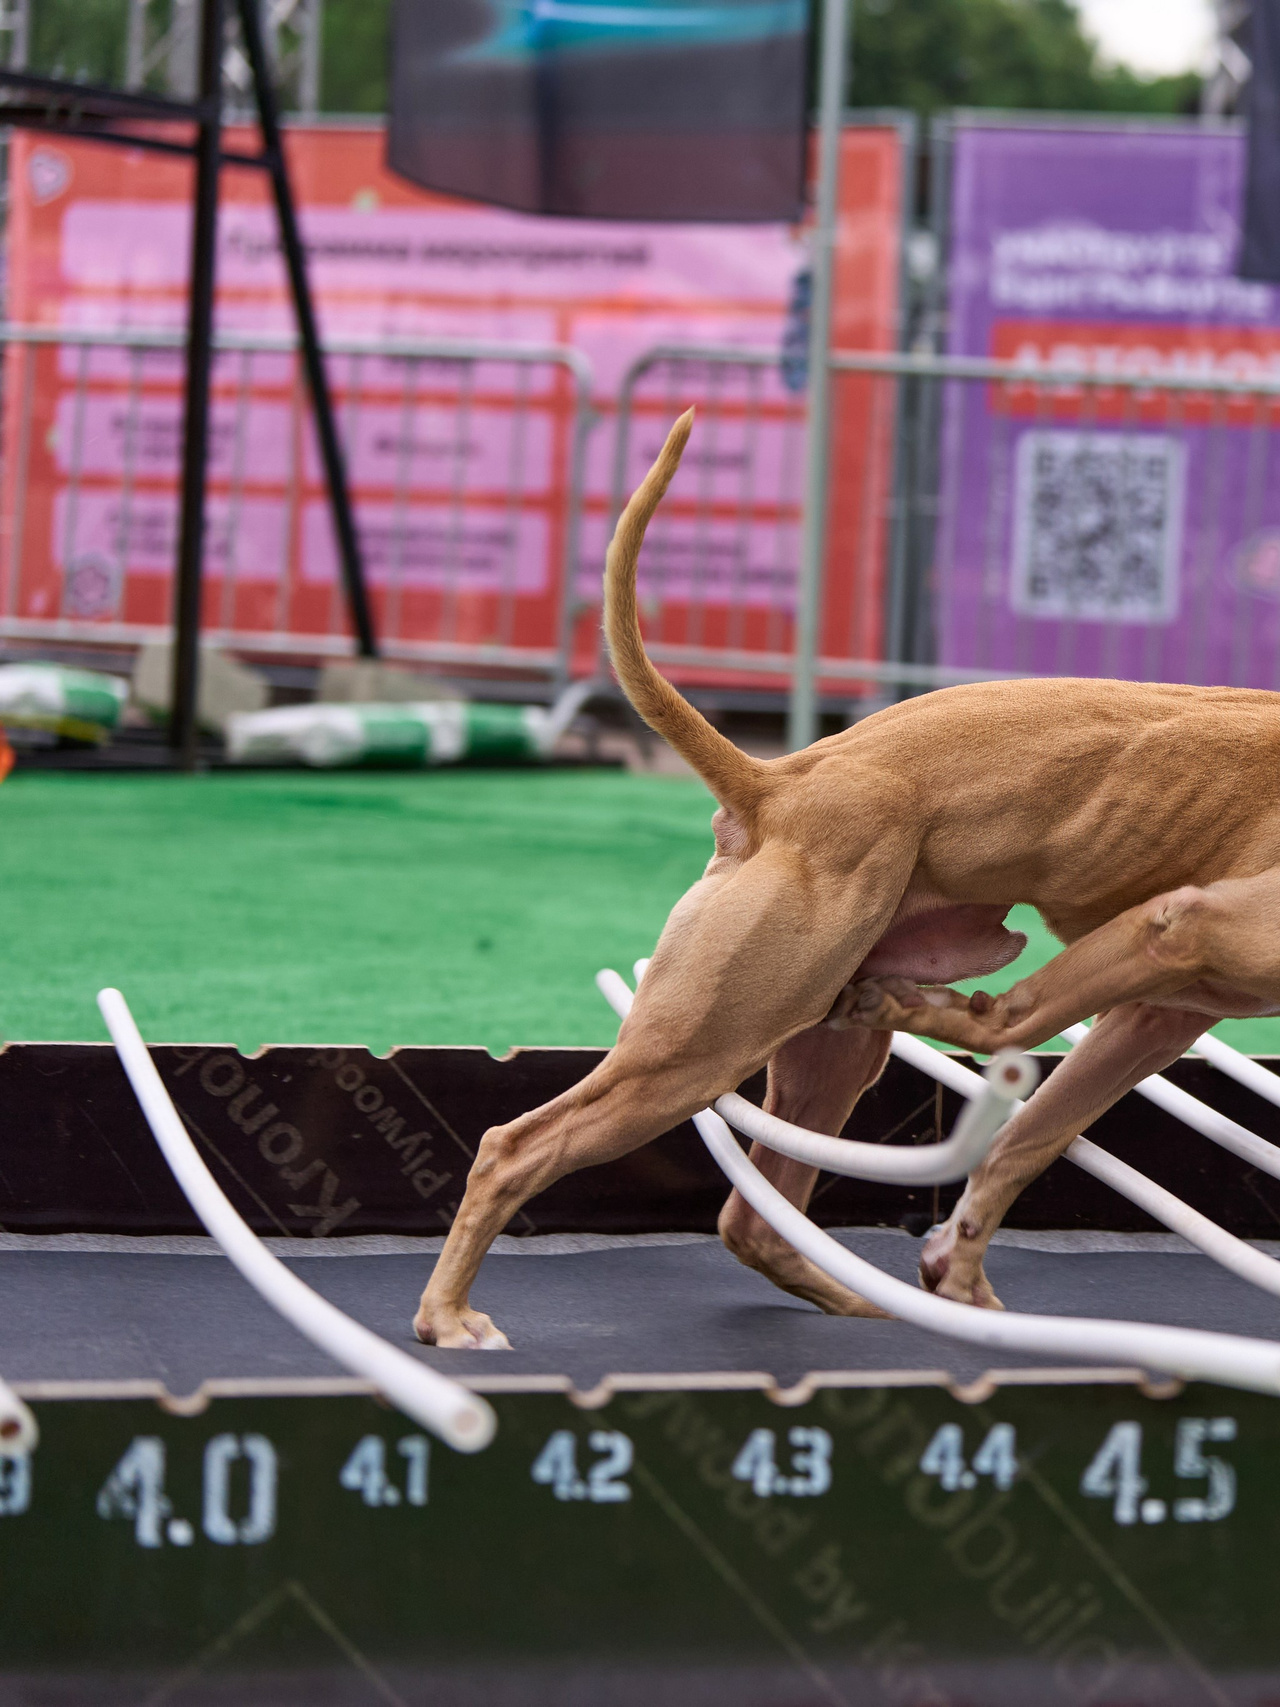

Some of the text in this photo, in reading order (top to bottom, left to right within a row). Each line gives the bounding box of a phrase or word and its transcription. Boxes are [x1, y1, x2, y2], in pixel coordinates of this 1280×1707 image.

[97, 1433, 278, 1548] 4.0
[340, 1434, 431, 1506] 4.1
[531, 1430, 634, 1502] 4.2
[731, 1426, 833, 1498] 4.3
[920, 1422, 1018, 1491] 4.4
[1080, 1416, 1238, 1526] 4.5
